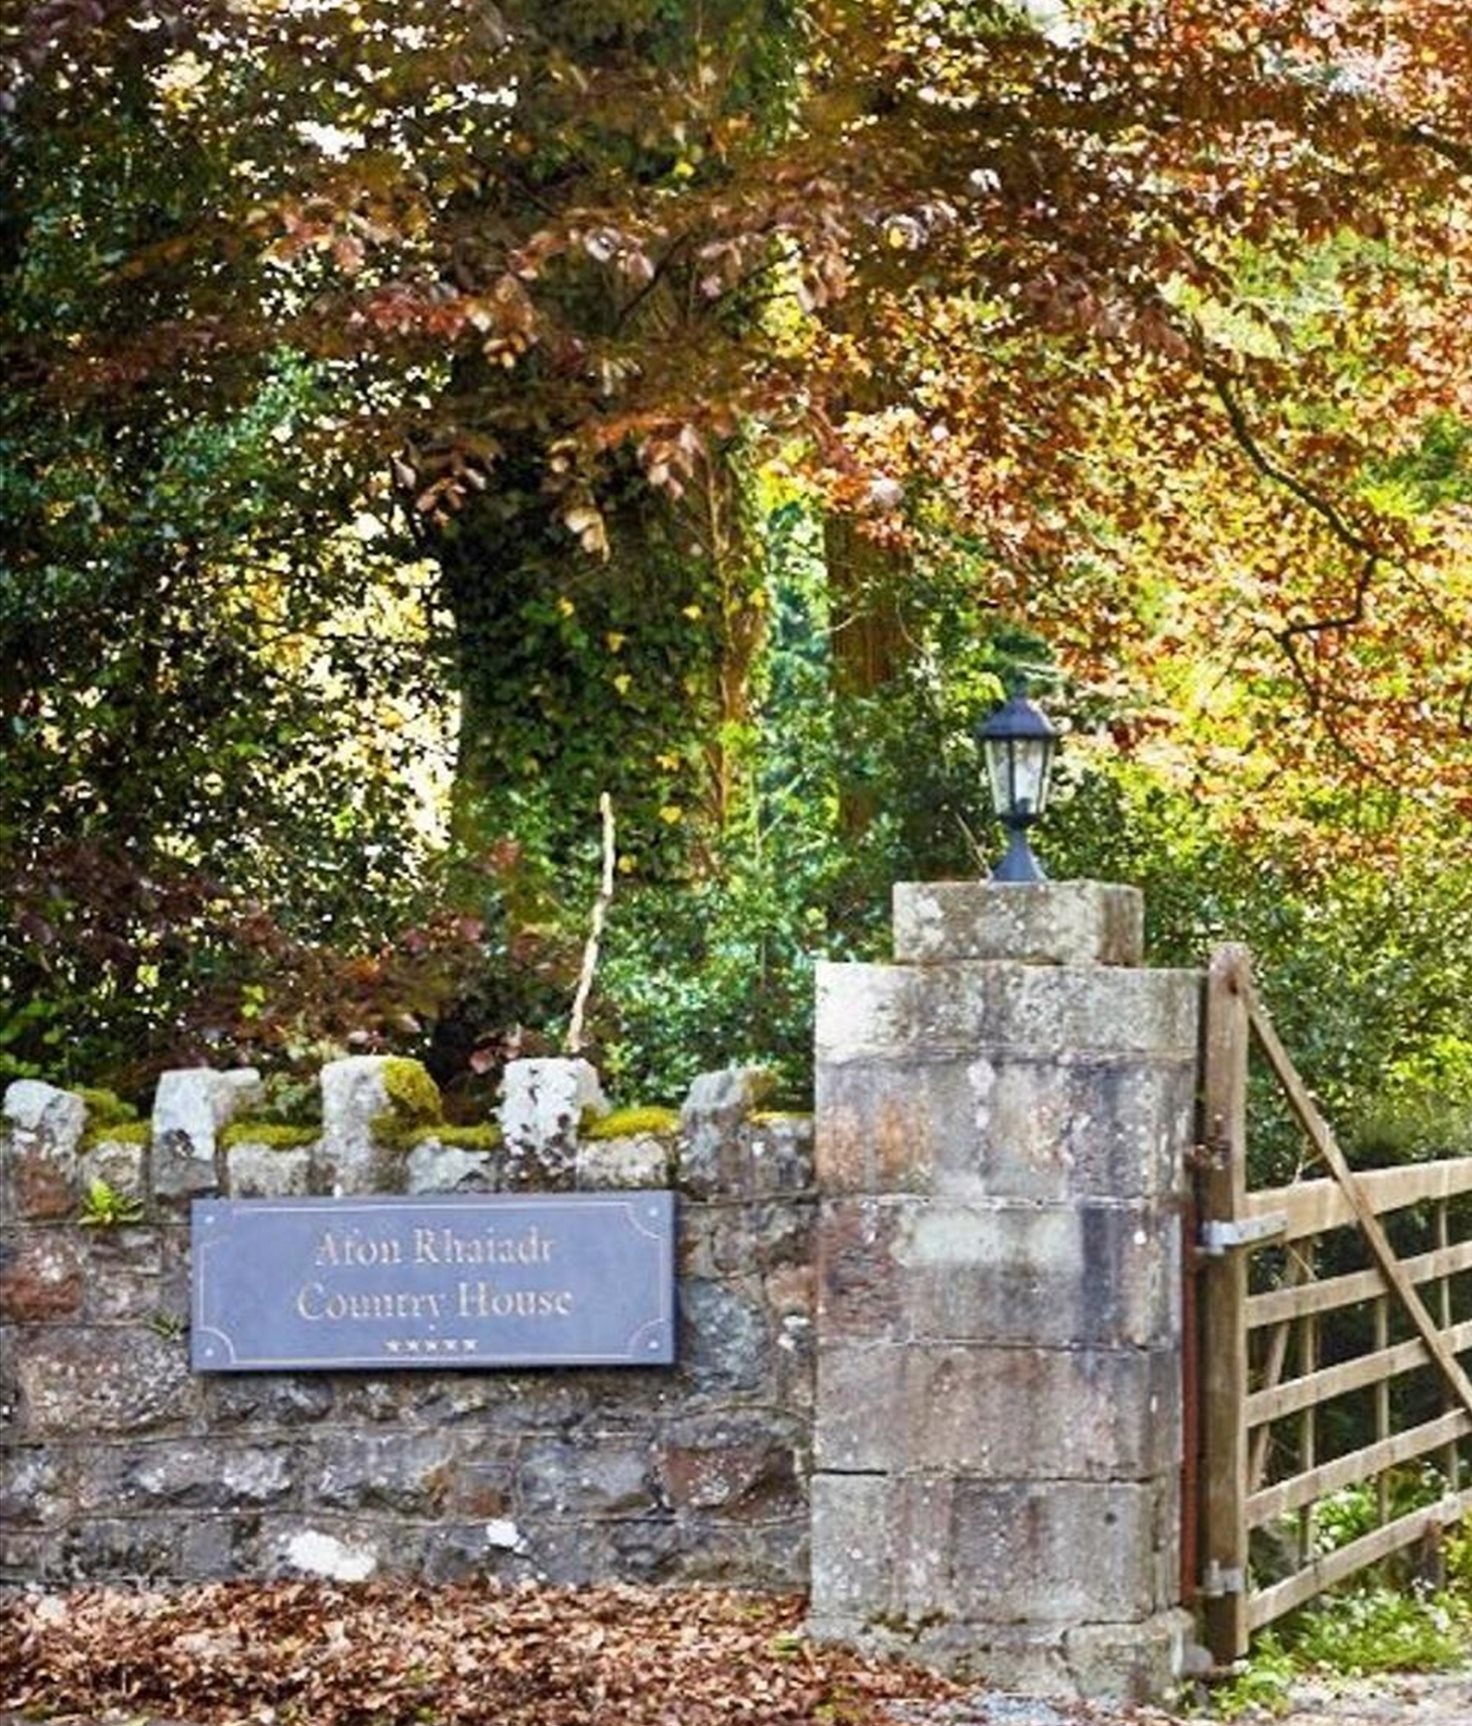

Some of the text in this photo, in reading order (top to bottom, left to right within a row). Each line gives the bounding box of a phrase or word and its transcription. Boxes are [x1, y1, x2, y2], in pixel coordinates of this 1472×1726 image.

[315, 1224, 555, 1266] Afon Rhaiadr
[297, 1281, 573, 1328] Country House
